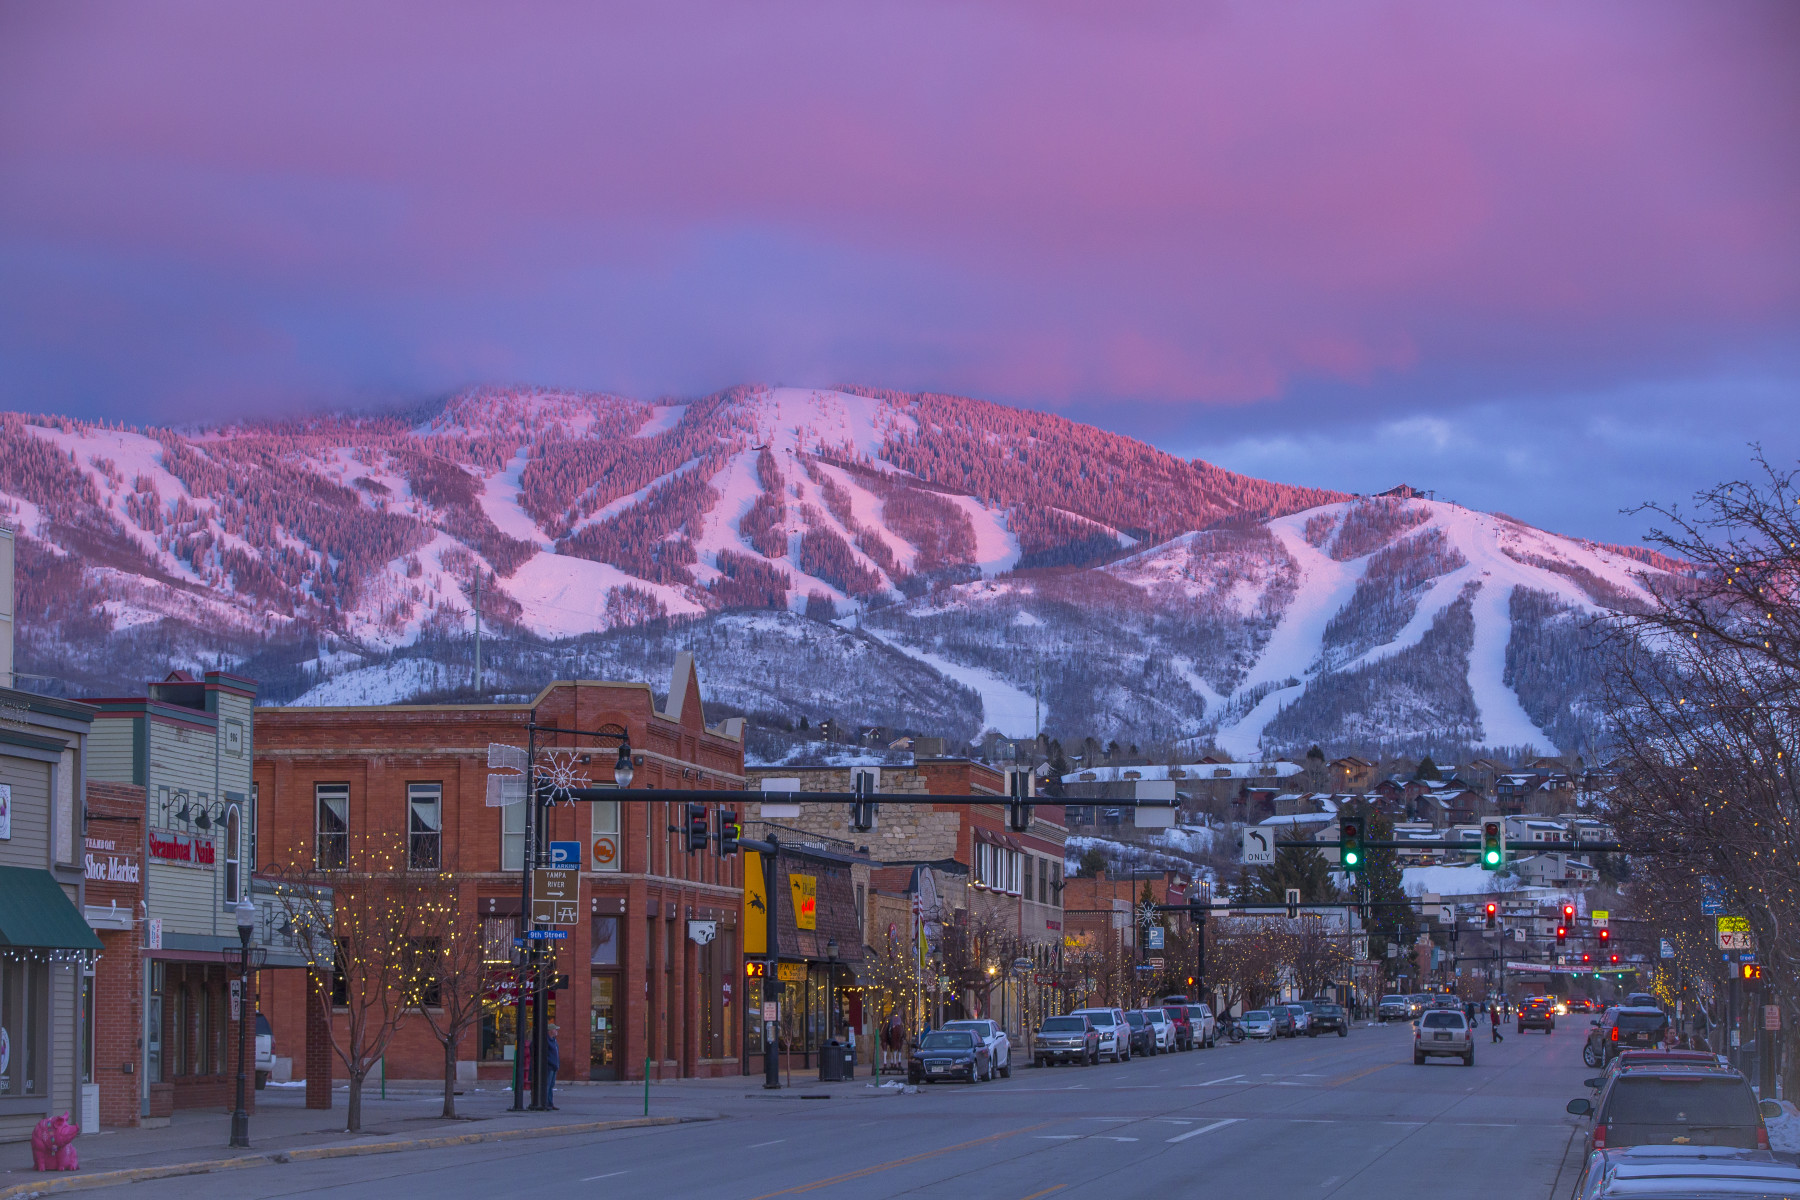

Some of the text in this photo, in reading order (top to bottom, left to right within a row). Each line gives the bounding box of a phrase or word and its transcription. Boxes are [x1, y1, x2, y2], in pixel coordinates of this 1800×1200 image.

[149, 832, 215, 864] Steamboat Nails
[85, 853, 140, 882] Shoe Market
[546, 871, 567, 879] YAMPA
[530, 931, 566, 939] 9th Street
